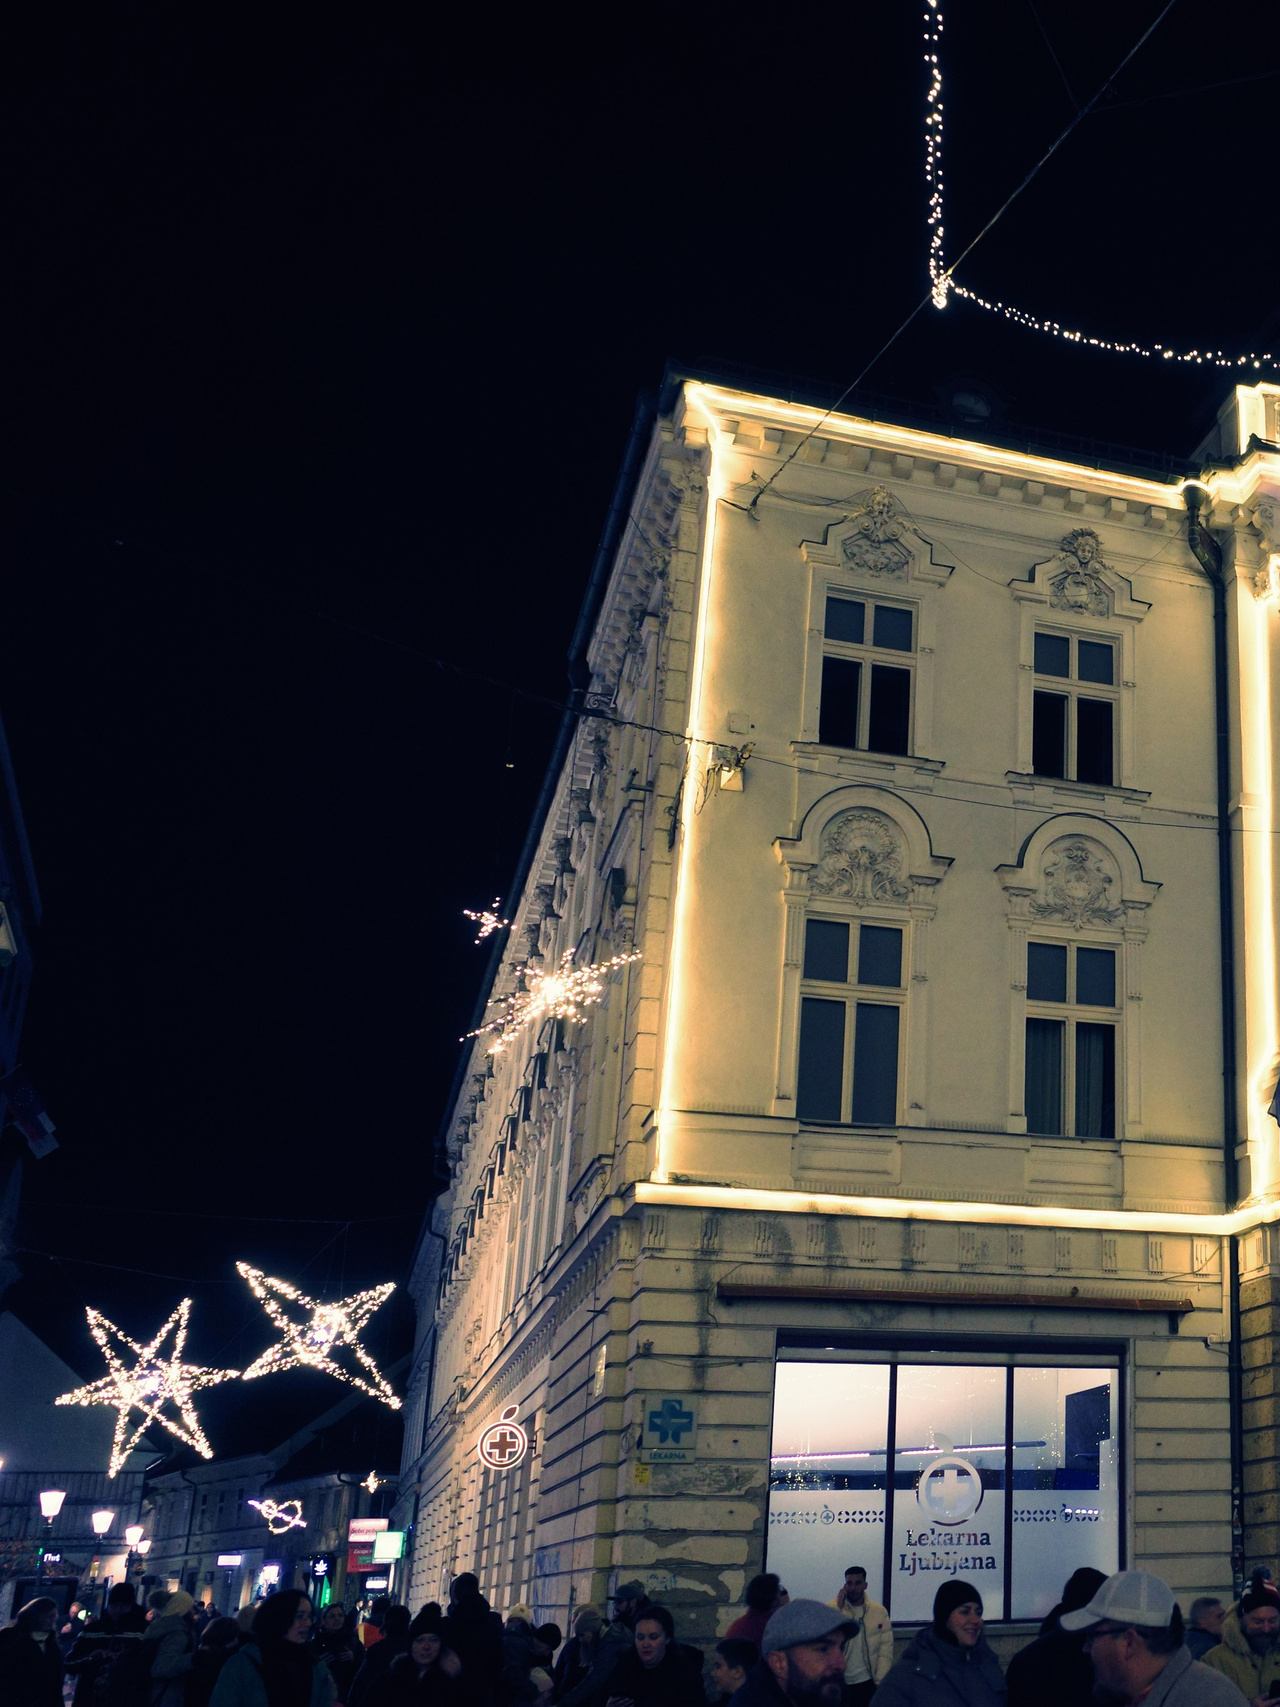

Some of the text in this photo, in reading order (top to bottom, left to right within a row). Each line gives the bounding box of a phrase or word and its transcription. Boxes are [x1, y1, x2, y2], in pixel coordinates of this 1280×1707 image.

[649, 1452, 687, 1460] LEKARNA
[906, 1528, 992, 1547] Lekarna
[899, 1551, 997, 1576] Ljubljana
